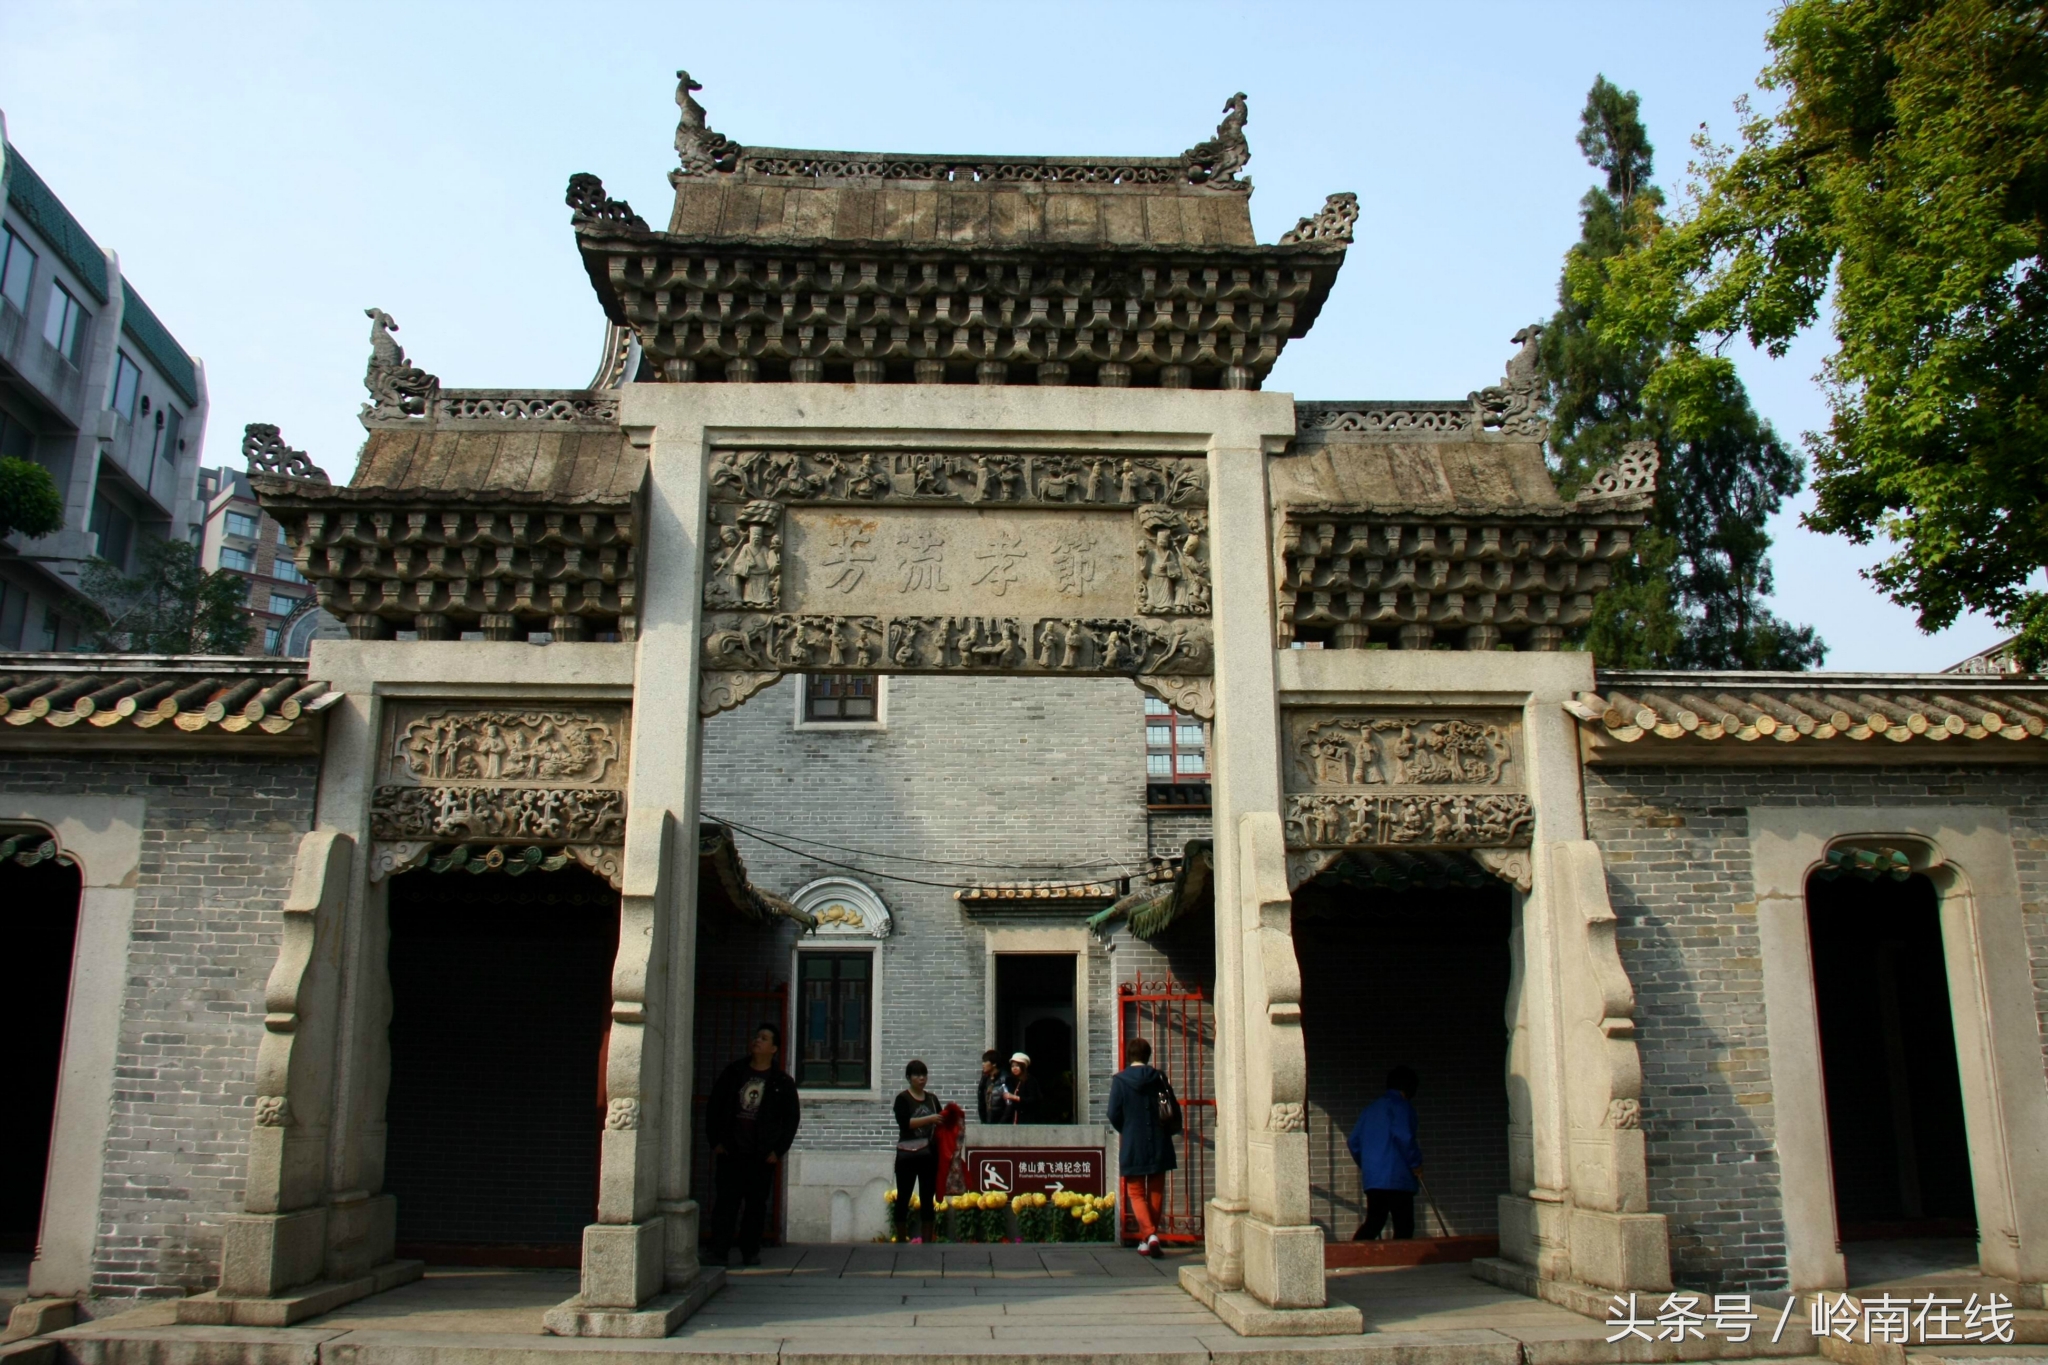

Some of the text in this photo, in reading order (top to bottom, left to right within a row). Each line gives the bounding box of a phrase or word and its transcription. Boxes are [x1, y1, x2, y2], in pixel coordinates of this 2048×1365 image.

[1019, 1161, 1091, 1173] 佛山黄飞鸿纪念馆
